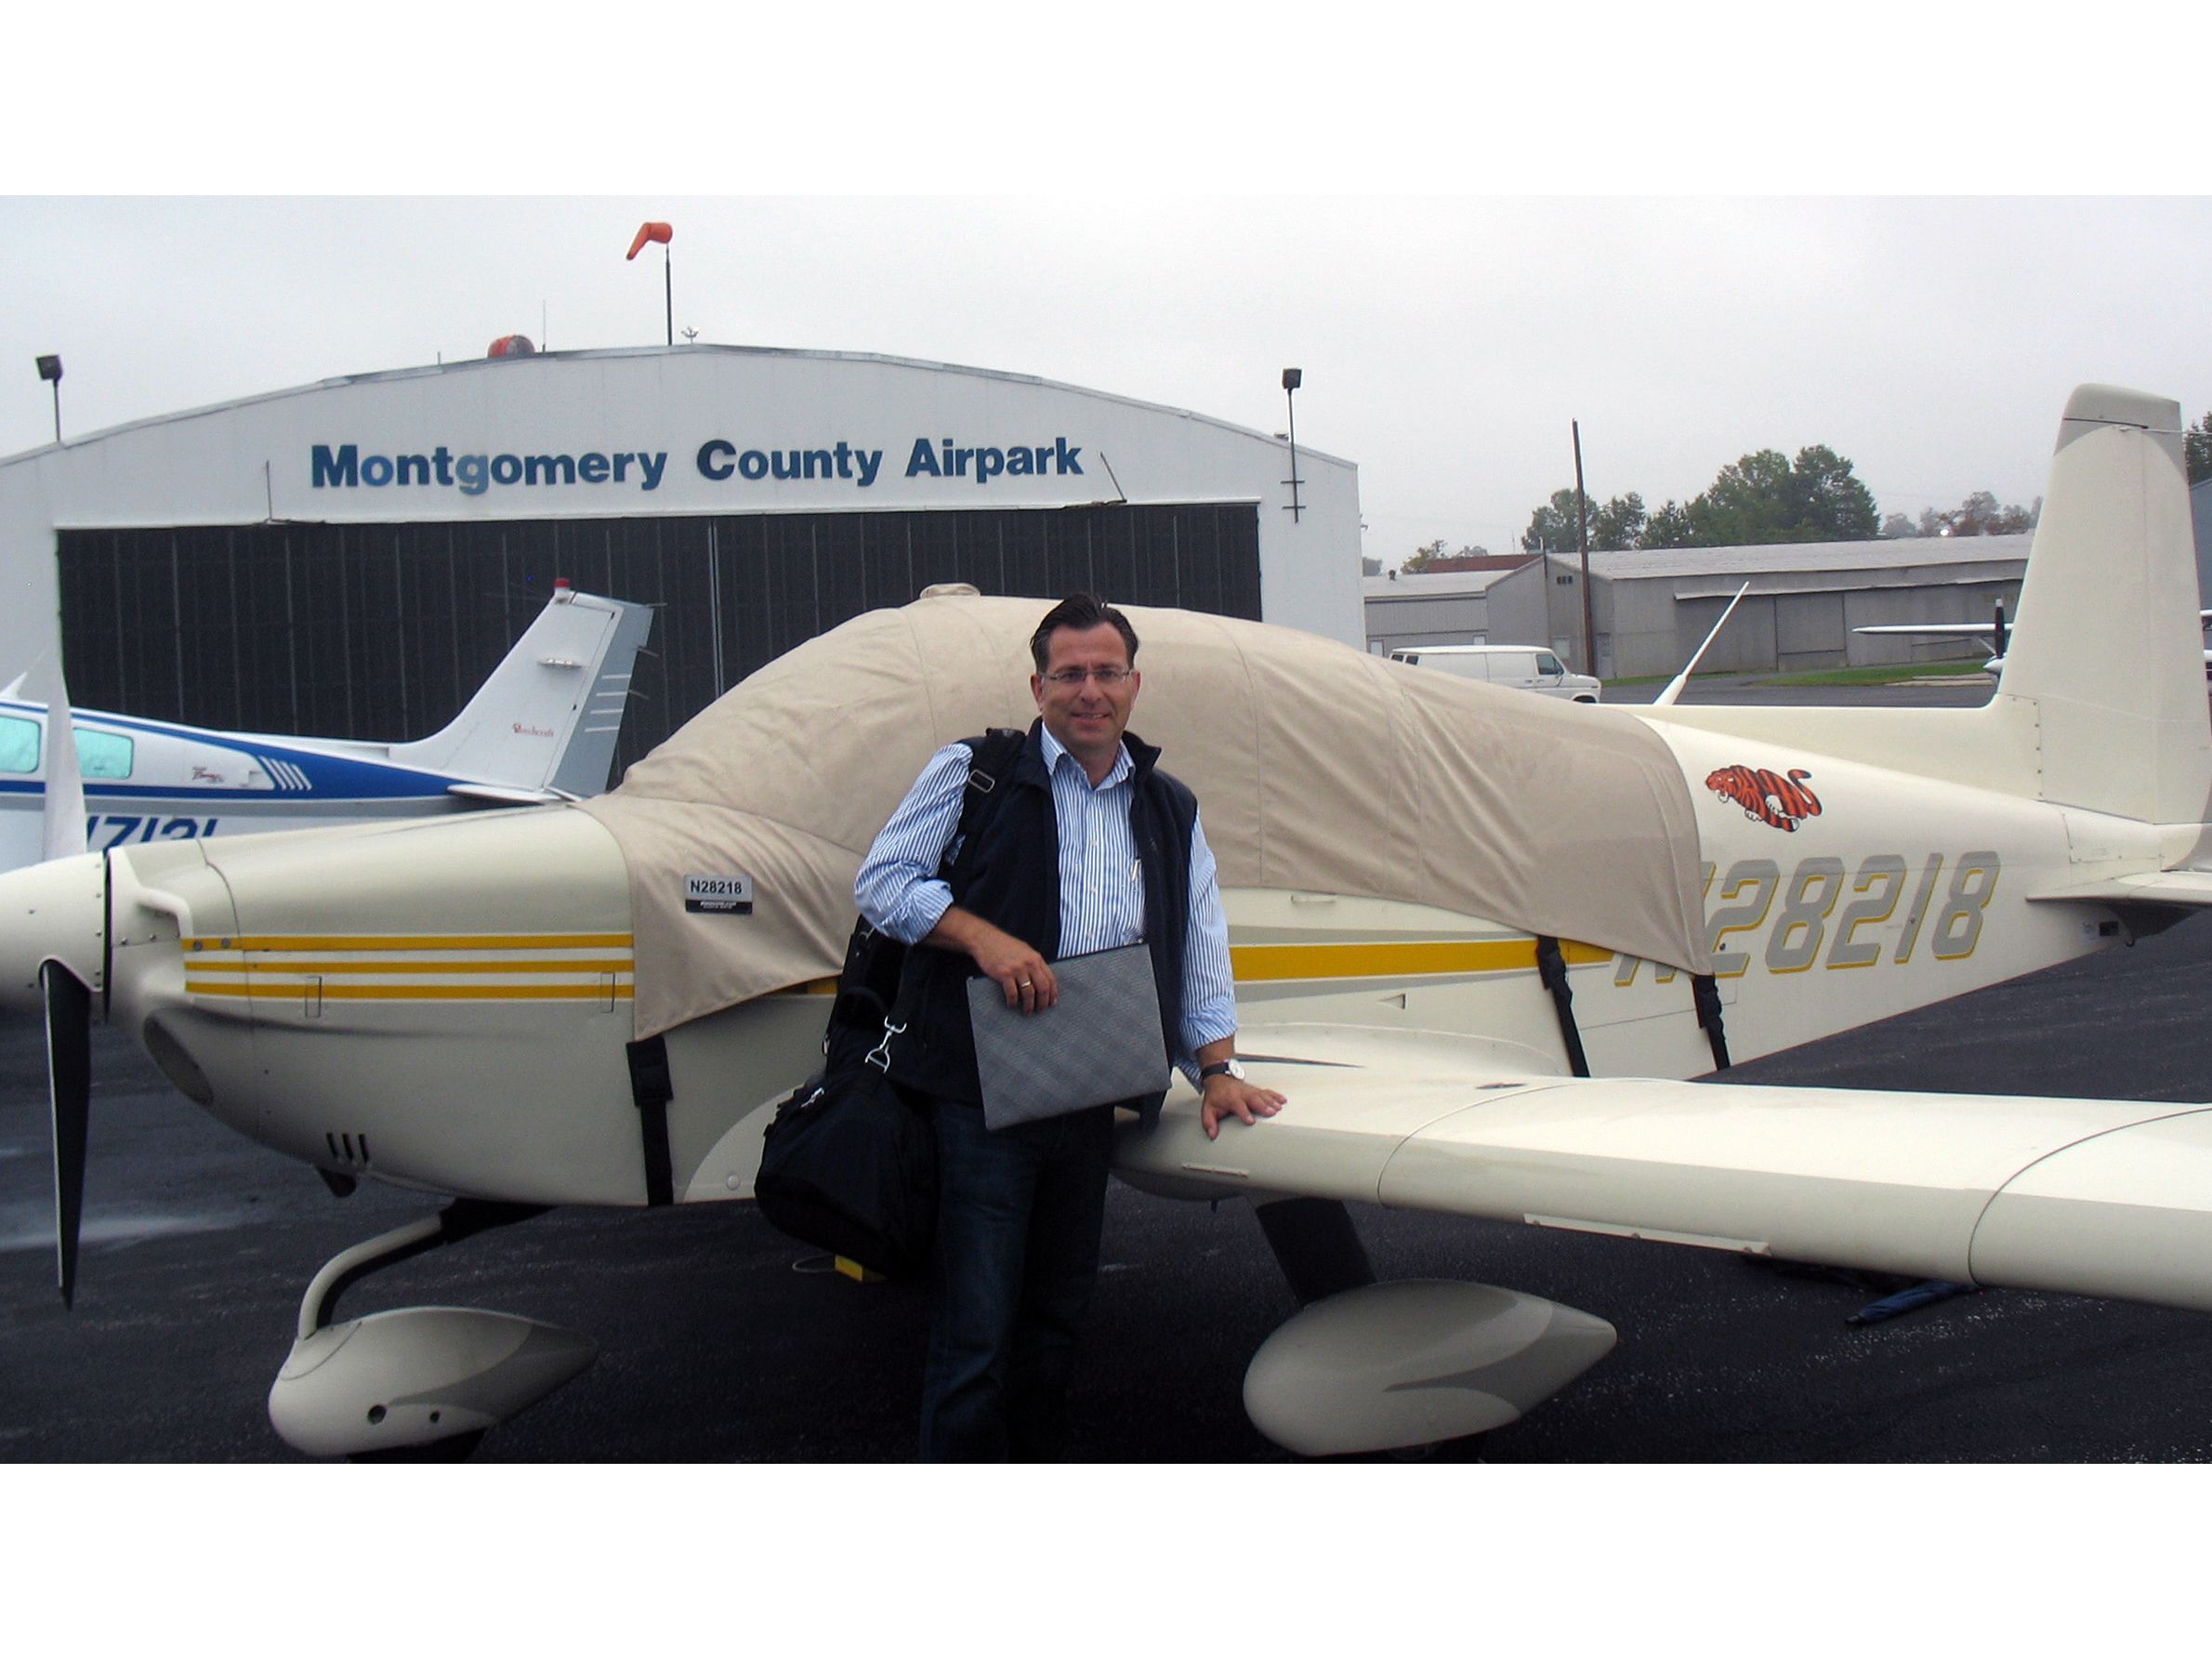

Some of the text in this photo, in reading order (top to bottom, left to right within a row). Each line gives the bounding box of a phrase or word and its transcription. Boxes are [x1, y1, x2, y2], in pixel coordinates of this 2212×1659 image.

[311, 437, 1085, 495] Montgomery County Airpark
[691, 880, 743, 894] N28218
